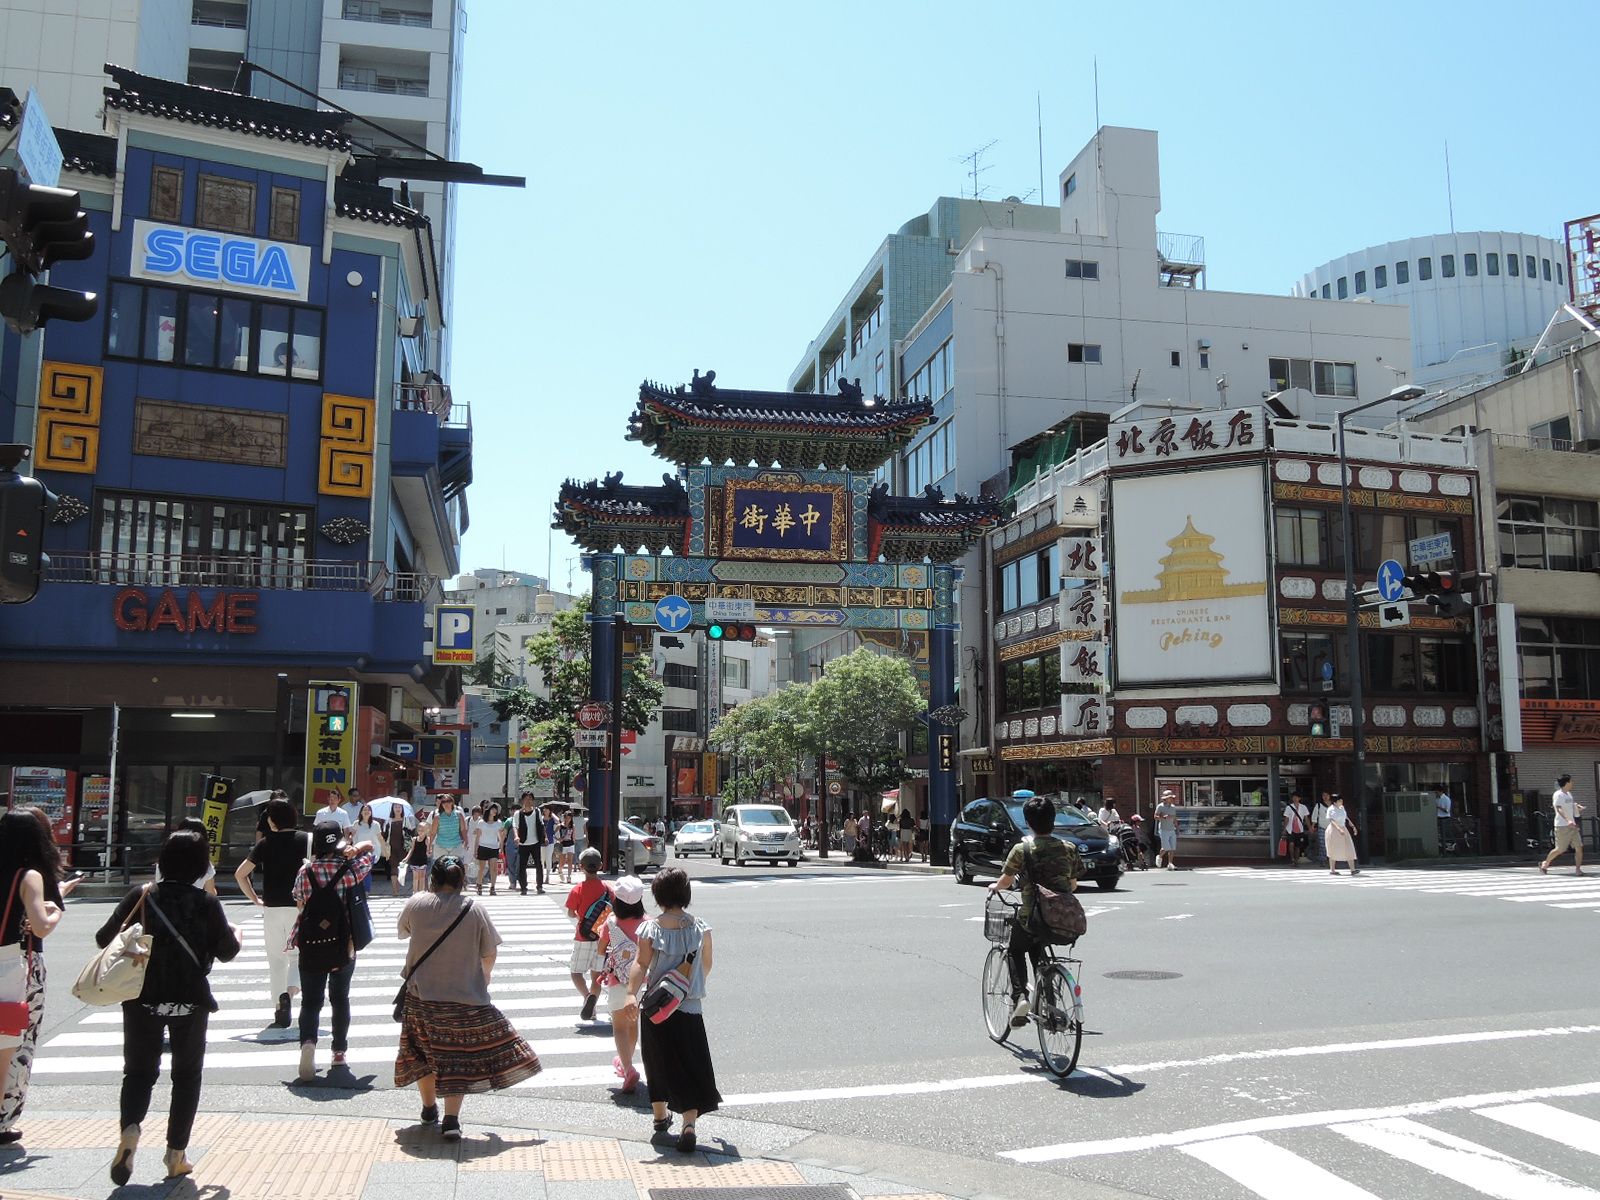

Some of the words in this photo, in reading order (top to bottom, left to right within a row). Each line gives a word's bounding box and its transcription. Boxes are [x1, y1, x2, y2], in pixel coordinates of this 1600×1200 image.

[145, 228, 298, 291] SEGA
[1115, 409, 1254, 457] 北京飯店
[113, 587, 258, 633] GAME
[1151, 616, 1204, 624] RESTAURANT
[1176, 607, 1209, 615] CHINESE
[440, 612, 470, 647] P
[1068, 540, 1103, 730] 北京飯店
[211, 782, 228, 800] P
[312, 768, 346, 783] IN
